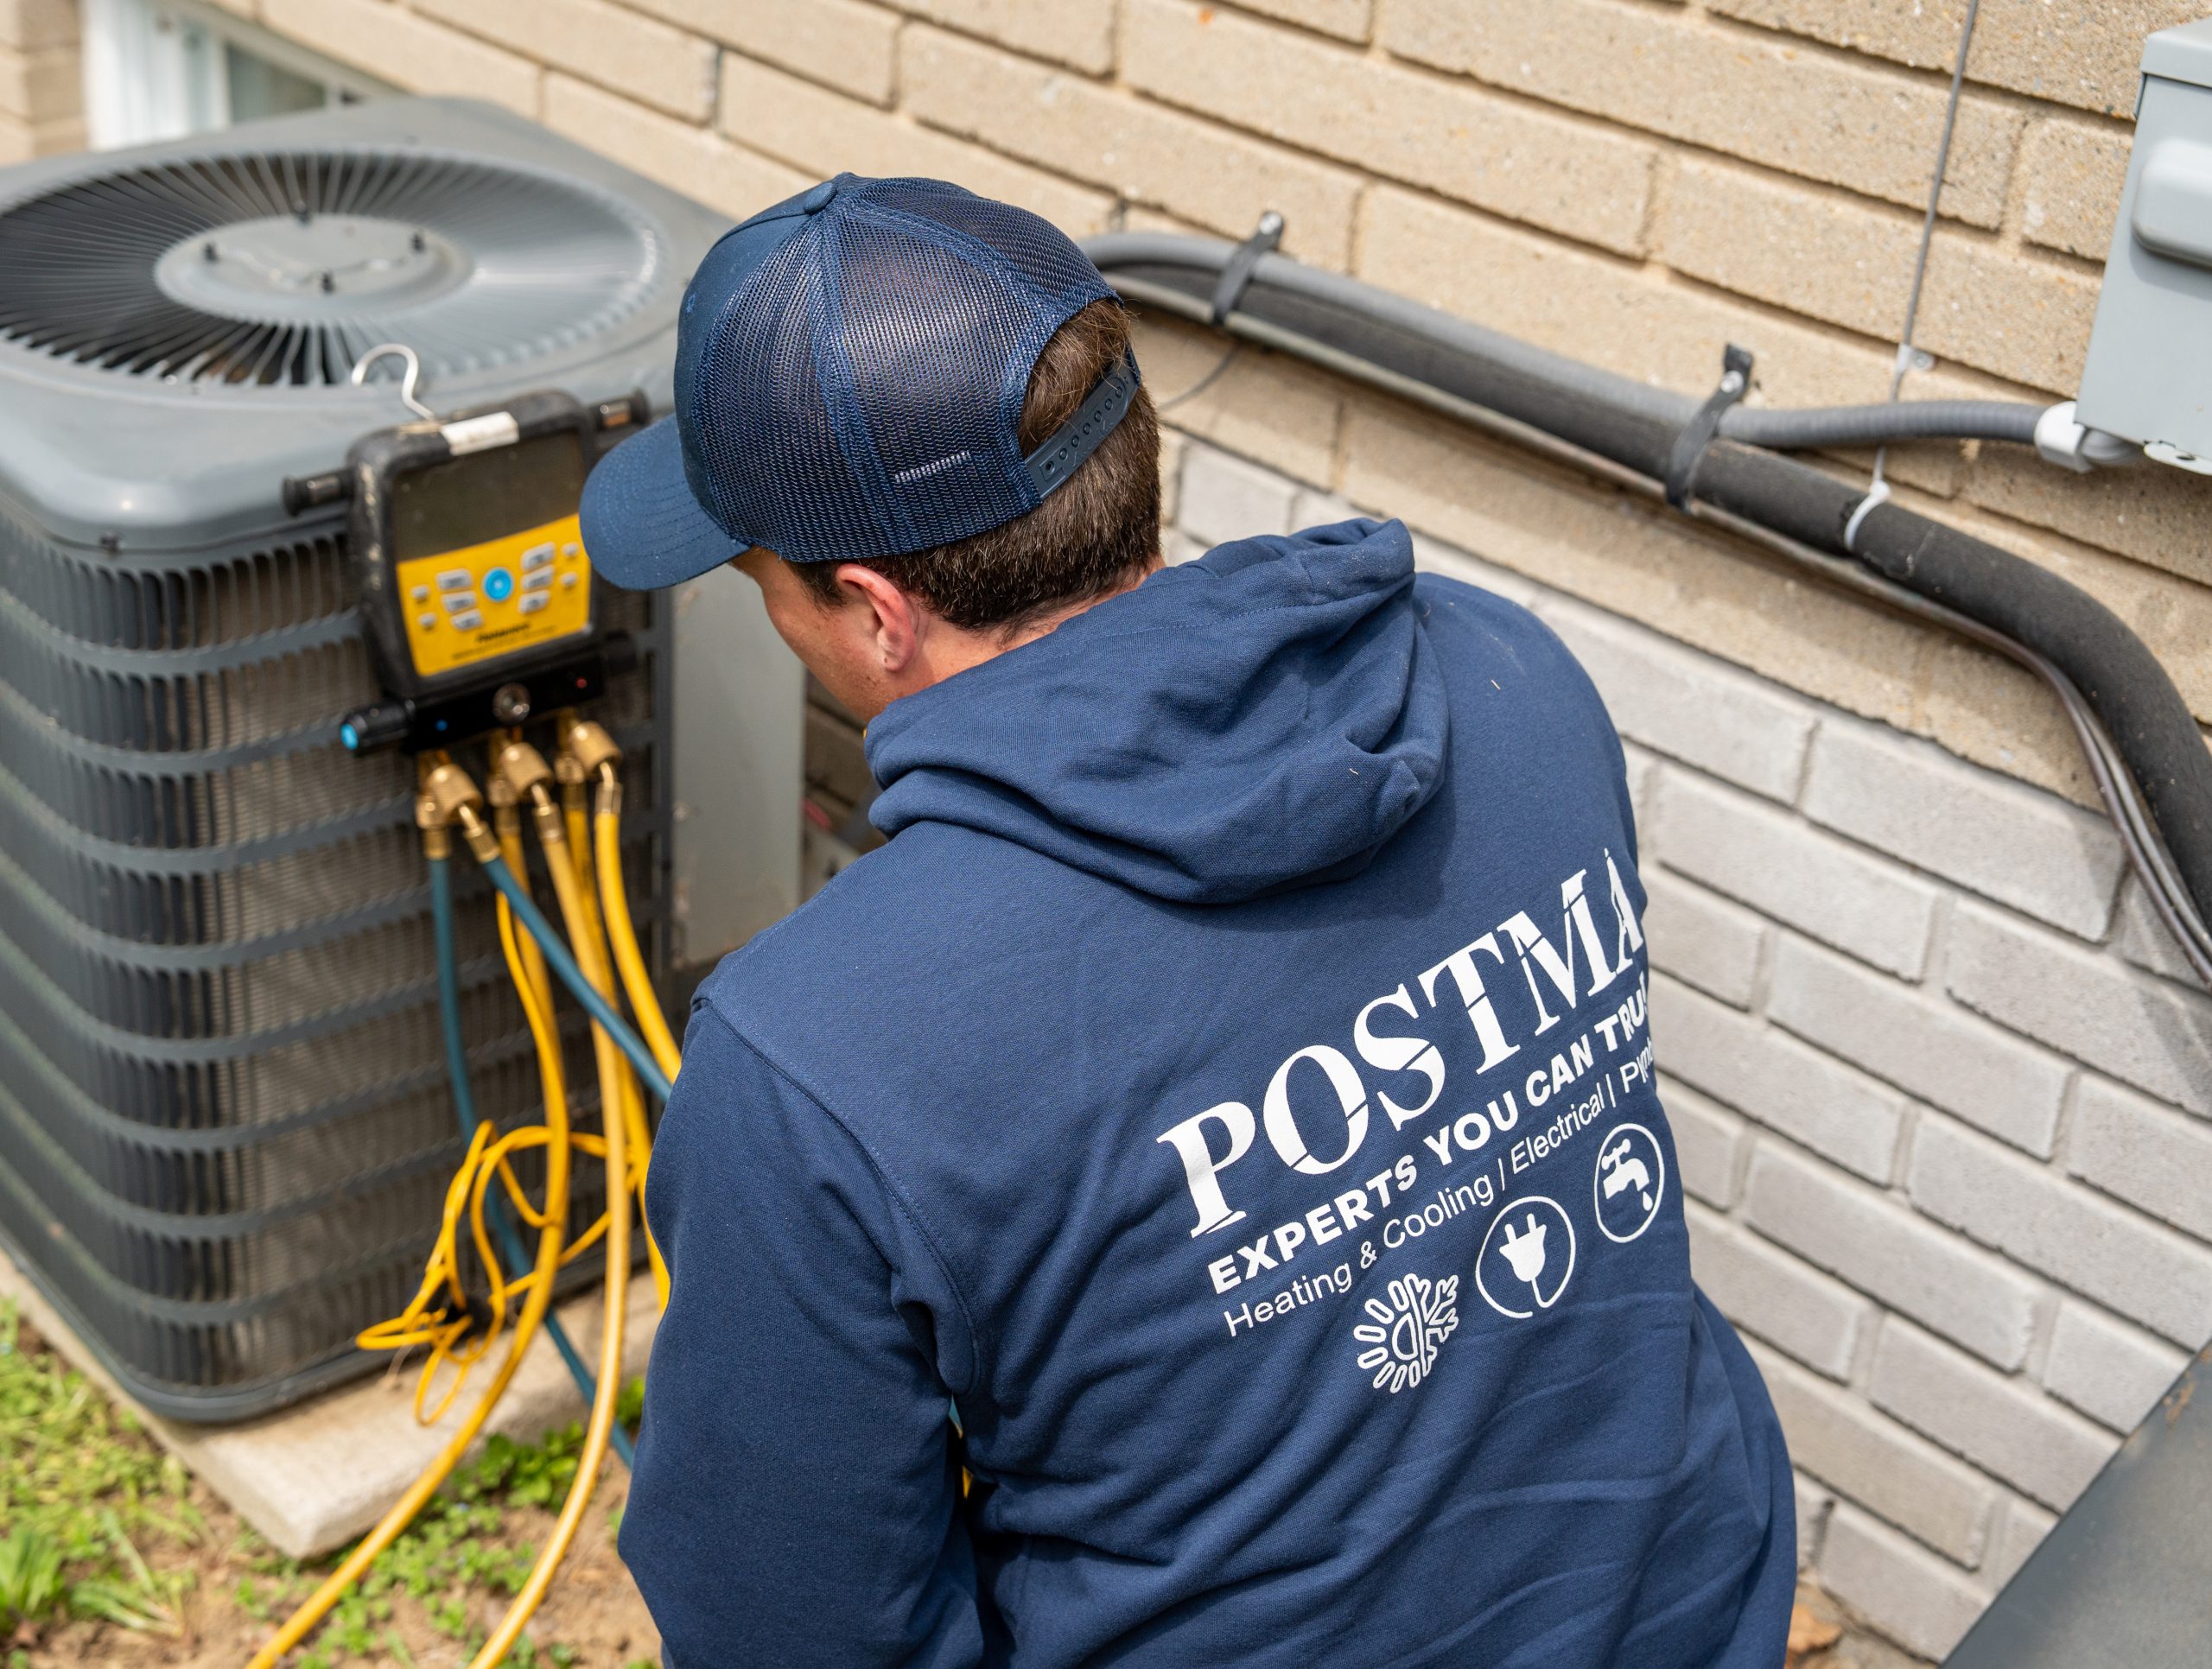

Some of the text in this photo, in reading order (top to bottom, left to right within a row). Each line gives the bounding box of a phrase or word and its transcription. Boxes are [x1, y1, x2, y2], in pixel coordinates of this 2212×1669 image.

[1207, 1154, 1418, 1295] EXPERTS
[1422, 1089, 1519, 1166] YOU
[1525, 1033, 1595, 1107] CAN
[1223, 1262, 1352, 1337] Heating
[1359, 1241, 1377, 1270] &
[1382, 1174, 1495, 1250] Cooling
[1510, 1082, 1606, 1175] Electrical
